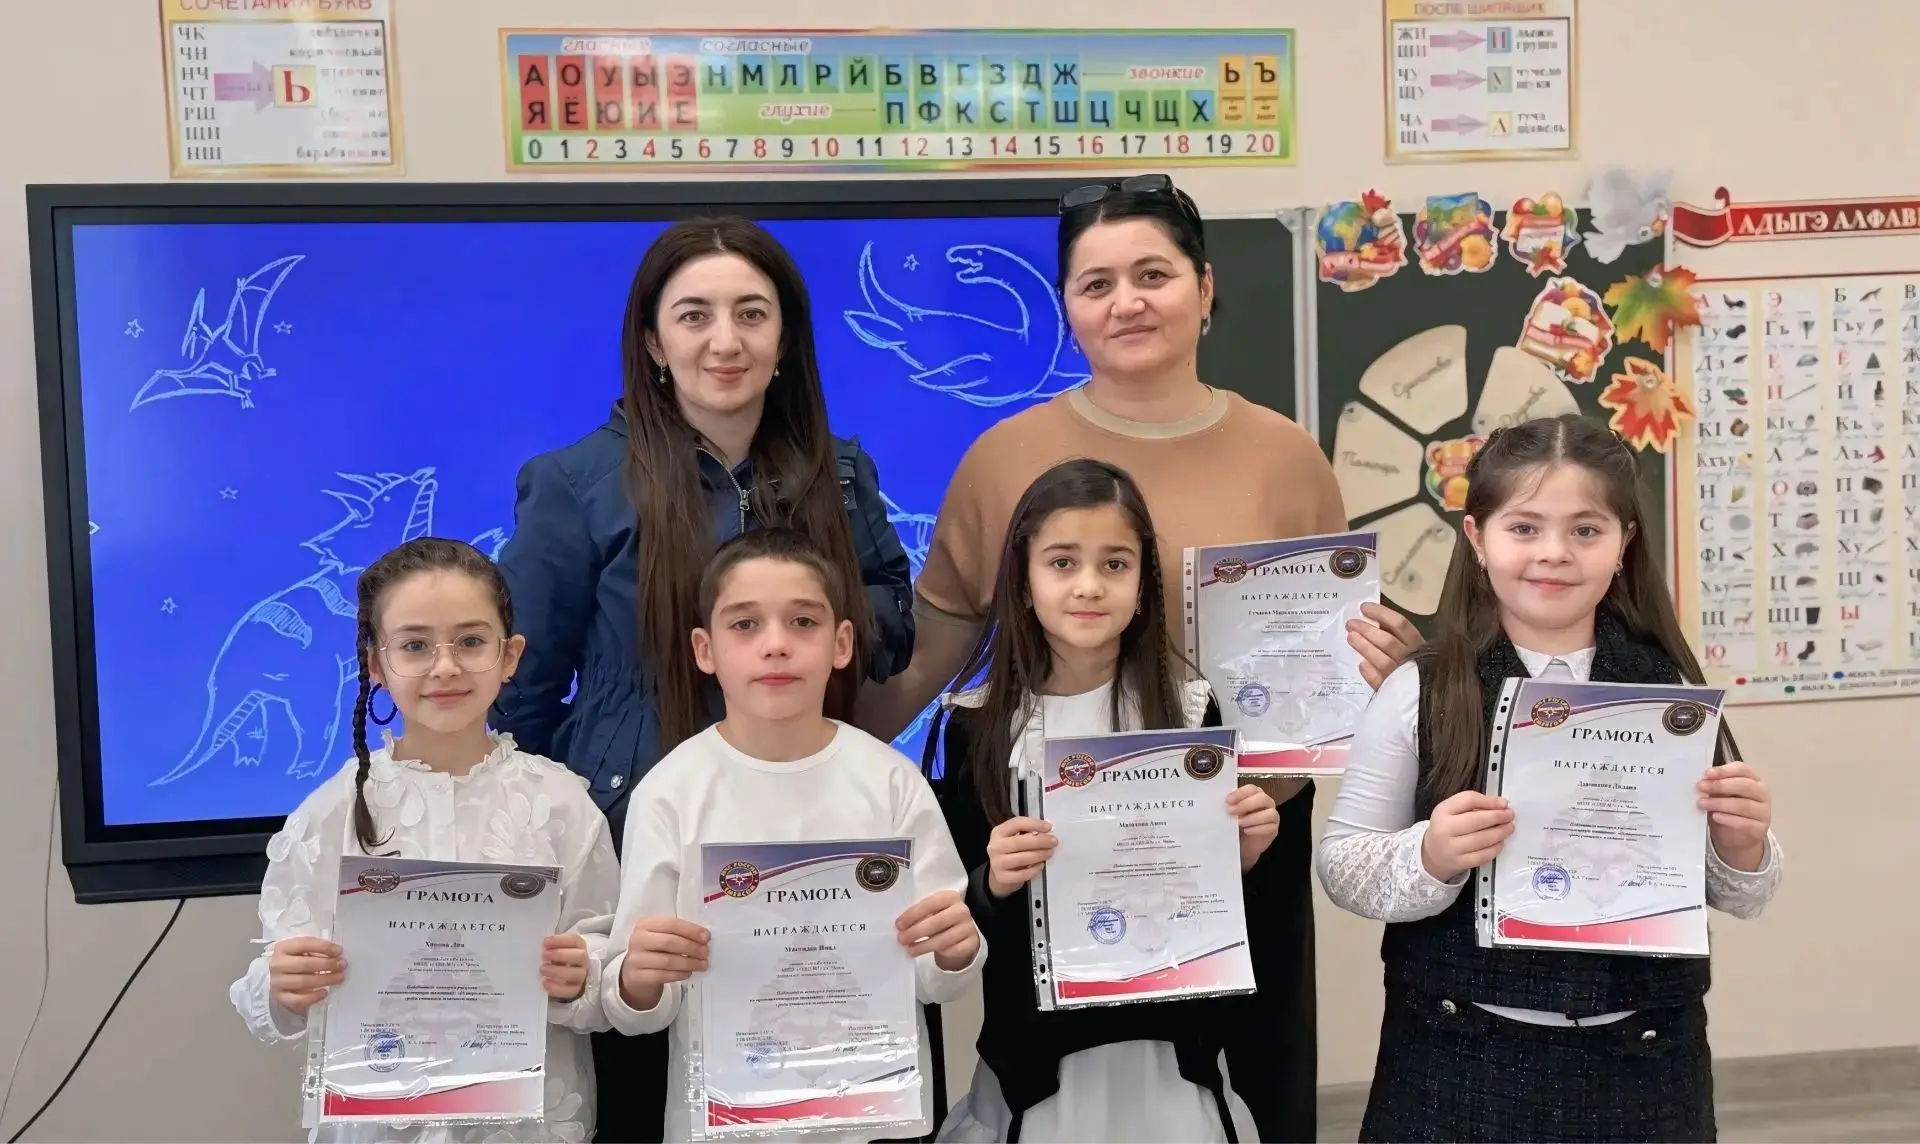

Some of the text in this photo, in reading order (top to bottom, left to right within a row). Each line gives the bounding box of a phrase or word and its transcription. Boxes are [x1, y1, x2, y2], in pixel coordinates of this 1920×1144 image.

[179, 27, 205, 41] ЧК
[703, 38, 808, 52] согласные
[180, 47, 207, 61] ЧН
[182, 67, 208, 81] НЧ
[524, 57, 1078, 90] А О У Ы Э Н М Л Р Й Б В Г З Д Ж
[1225, 62, 1276, 83] Ь Ъ
[184, 87, 206, 101] ЧТ
[283, 70, 310, 103] Ь
[528, 96, 691, 125] Я Ё Ю И Е
[887, 102, 904, 124] П
[918, 100, 941, 124] Ф
[957, 101, 974, 124] К
[990, 101, 1008, 123] С
[1025, 101, 1040, 124] Т
[1055, 101, 1078, 123] Ш
[1090, 101, 1110, 128] Ц
[1125, 101, 1141, 122] Ч
[1155, 101, 1180, 127] Щ
[1192, 101, 1210, 122] Х
[528, 133, 1274, 159] 0 1 2 3 4 5 6 7 8 9 10 11 12 13 14 15 16 17 18 19 20
[1738, 210, 1829, 236] АДЫГЭ
[1834, 287, 1847, 303] Б
[1905, 284, 1917, 299] В
[1699, 387, 1712, 404] З
[1700, 484, 1715, 499] Н
[1771, 480, 1788, 496] О
[1836, 477, 1851, 492] П
[1700, 516, 1714, 532] С
[1768, 512, 1783, 528] Т
[1772, 542, 1787, 559] Х
[1252, 562, 1327, 577] ГРАМОТА
[1241, 591, 1339, 602] НАГРАЖДАЕТСЯ
[1571, 727, 1655, 744] ГРАМОТА
[1102, 767, 1182, 782] ГРАМОТА
[1553, 760, 1665, 775] НАГРАЖДАЕТСЯ
[1090, 799, 1195, 814] НАГРАЖДАЕТСЯ
[405, 889, 495, 904] ГРАМОТА
[766, 887, 853, 903] ГРАМОТА
[389, 920, 507, 932] НАГРАЖДАЕТСЯ
[753, 923, 868, 937] НАГРАЖДАЕТСЯ
